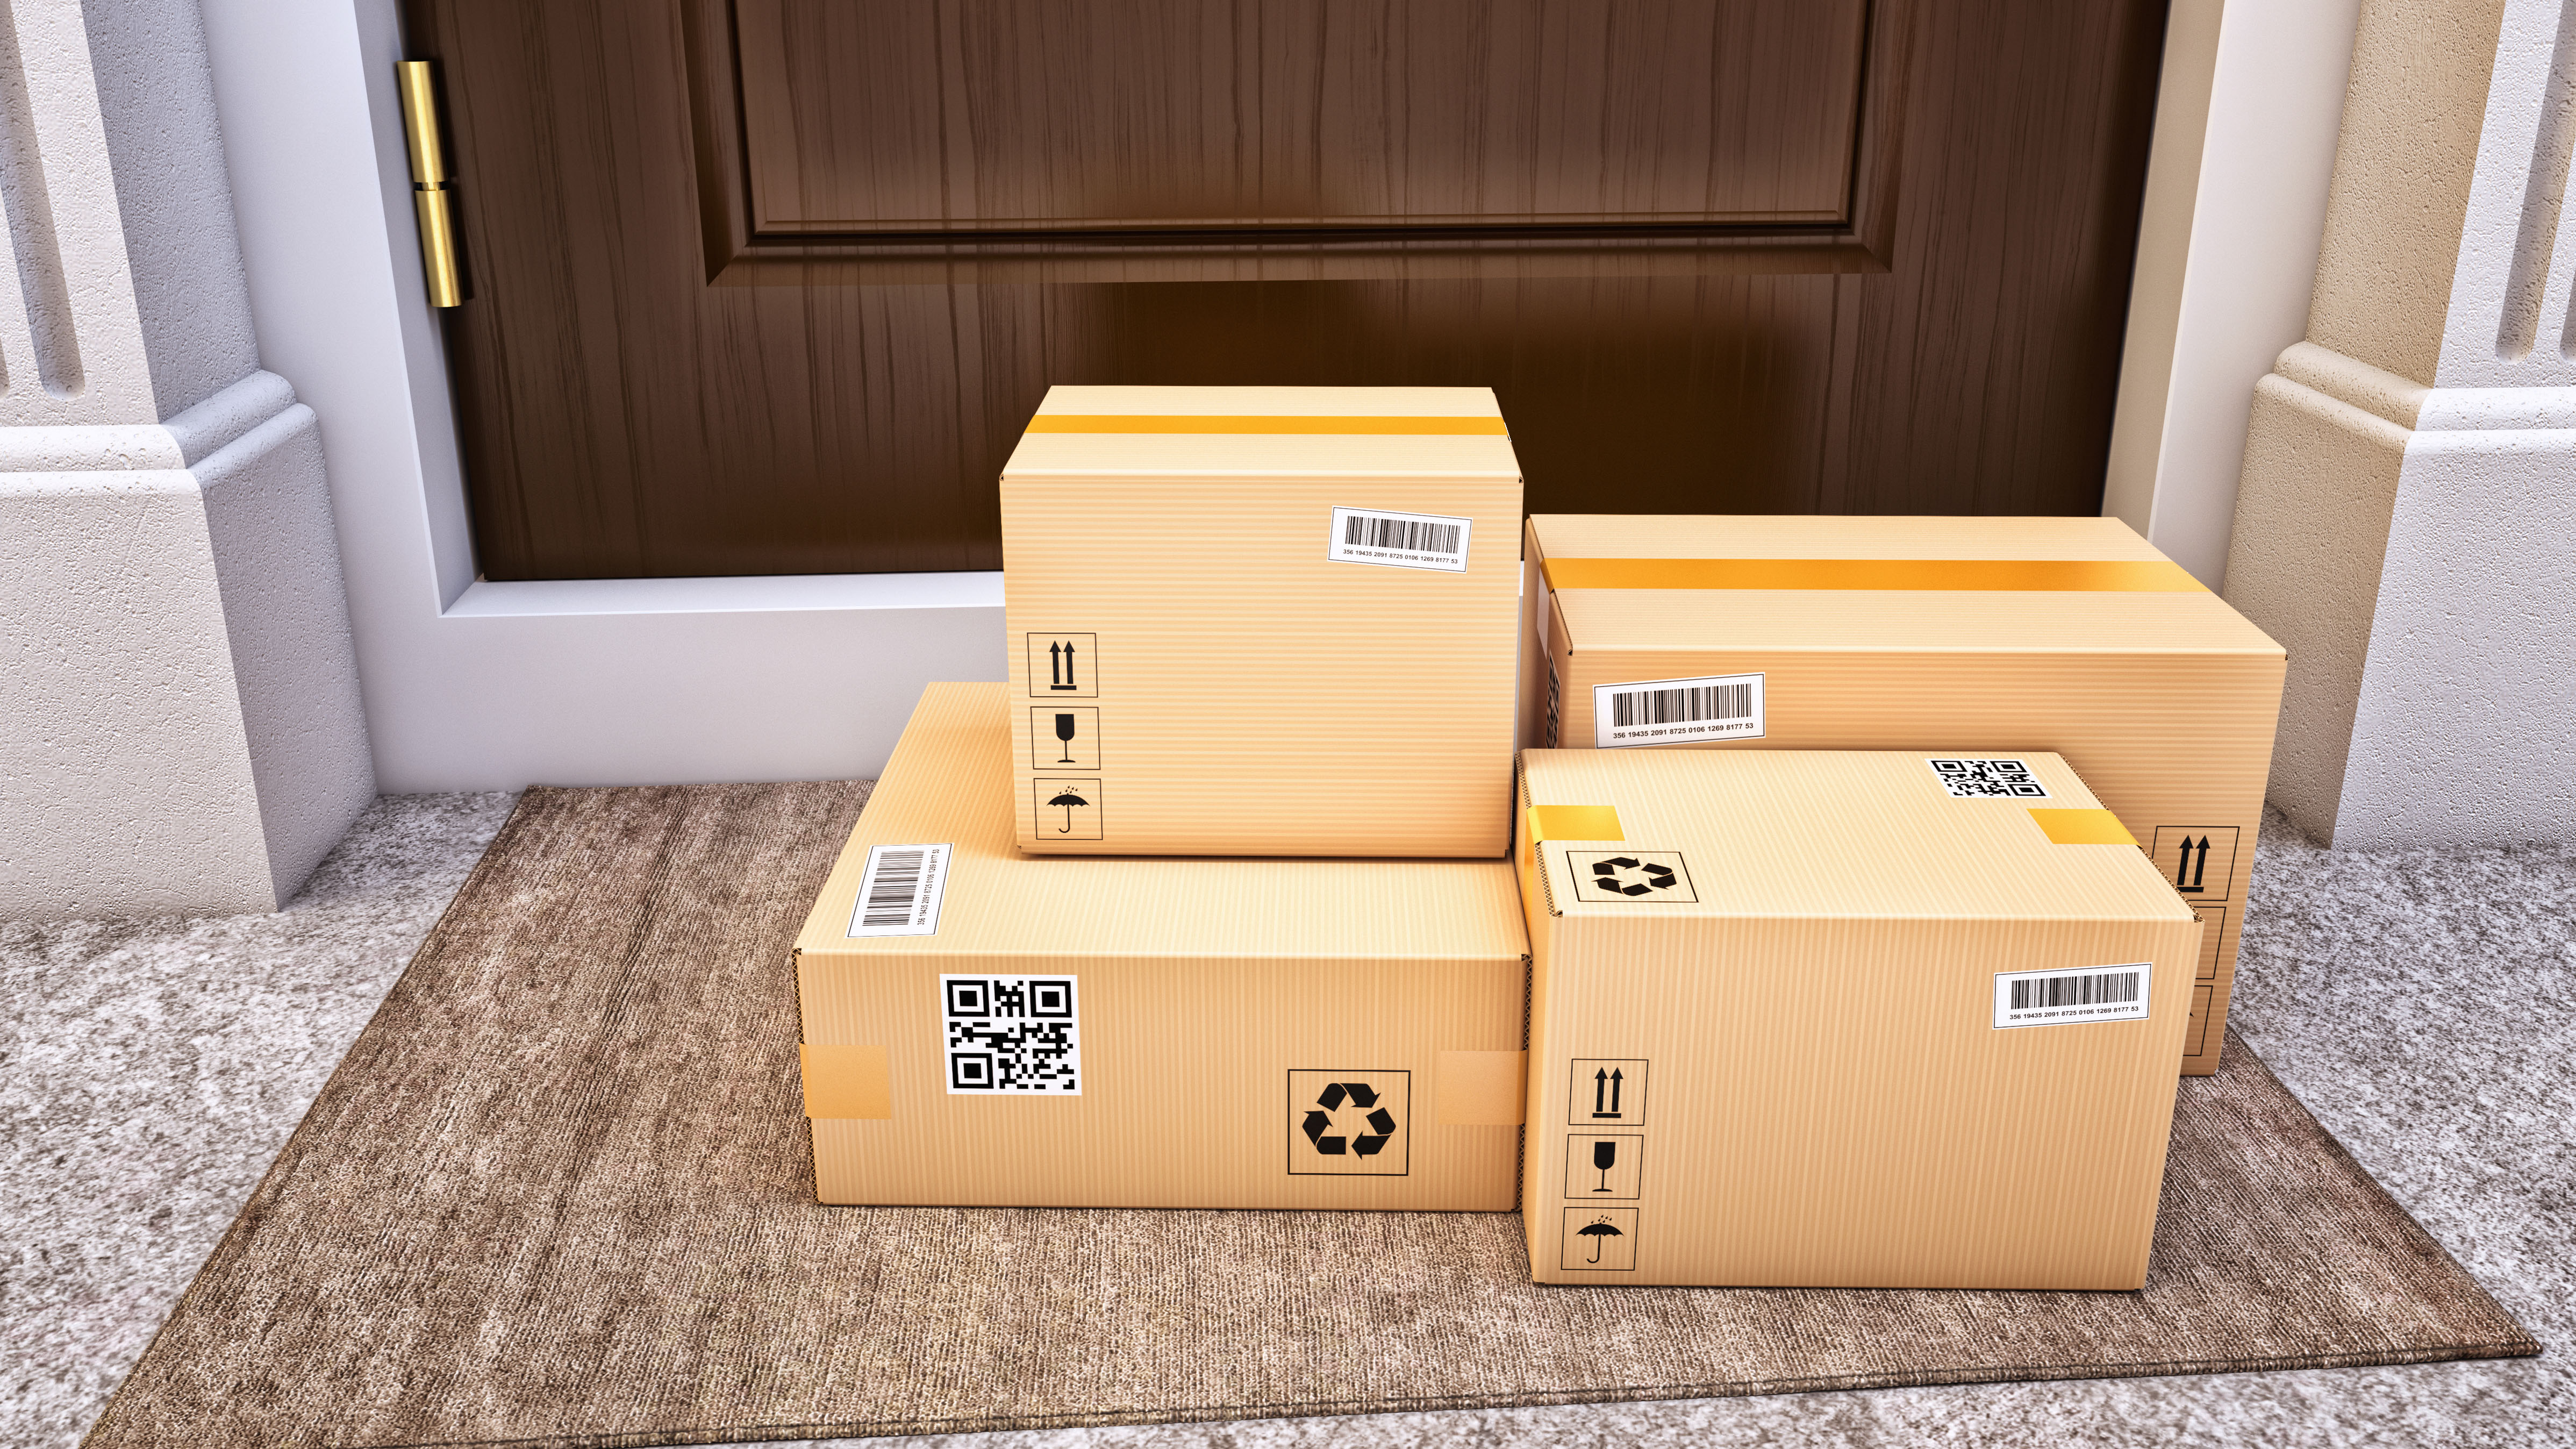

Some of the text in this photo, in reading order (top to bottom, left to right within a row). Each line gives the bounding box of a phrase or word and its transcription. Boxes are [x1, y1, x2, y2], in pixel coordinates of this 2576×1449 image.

[926, 874, 934, 883] 0106
[924, 884, 932, 893] 8725
[922, 895, 930, 904] 2091
[919, 905, 928, 916] 19435
